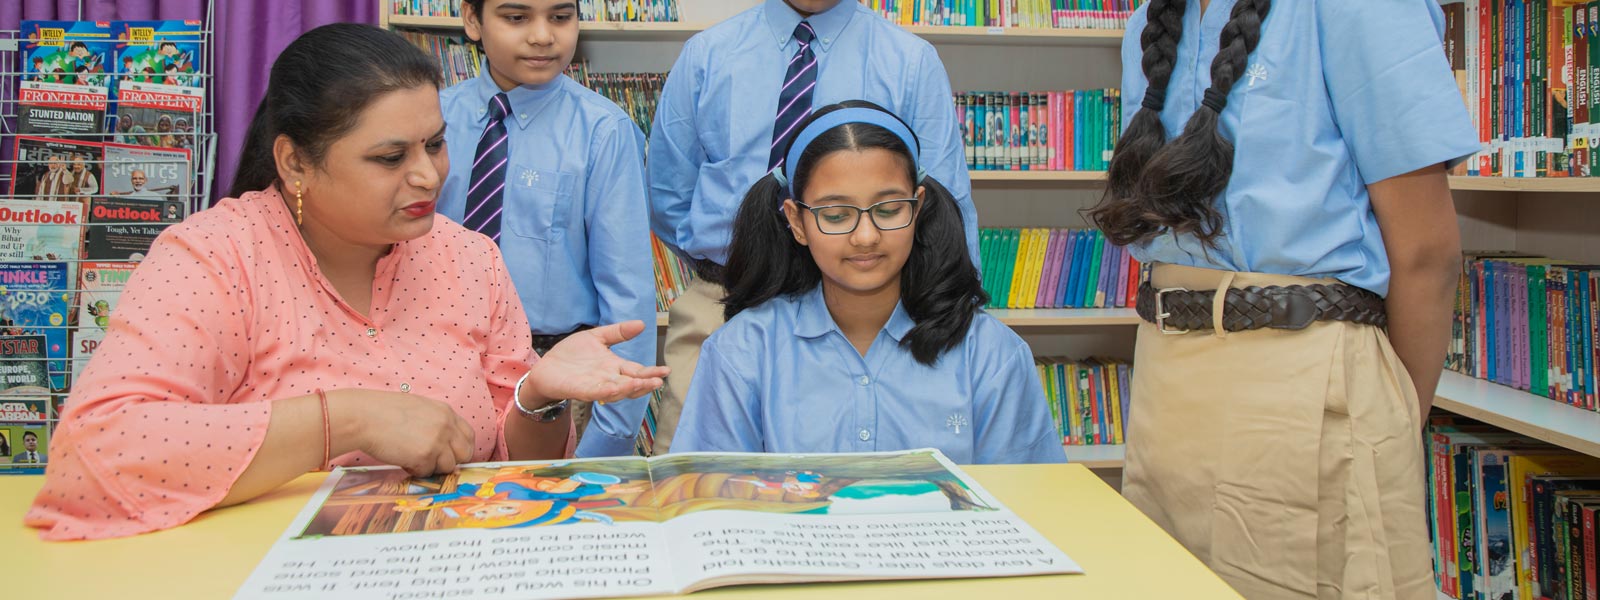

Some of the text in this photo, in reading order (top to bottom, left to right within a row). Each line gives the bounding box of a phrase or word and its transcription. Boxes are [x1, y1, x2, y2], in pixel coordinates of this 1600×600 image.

[22, 90, 105, 107] FRONTLINE
[122, 91, 200, 110] FRONTLINE
[30, 109, 94, 122] STUNTED NATION
[0, 207, 78, 224] Outlook
[93, 205, 160, 221] Outlook
[5, 227, 21, 236] Why
[106, 225, 128, 235] Tough,
[100, 270, 132, 283] TIN
[7, 375, 36, 383] WORLD
[866, 521, 966, 529] Pinocchio
[568, 532, 646, 541] wanted
[582, 543, 647, 551] music
[702, 538, 743, 547] The
[754, 538, 813, 548] boys.
[912, 540, 949, 548] just
[955, 538, 1032, 546] school,
[375, 542, 439, 553] show.
[492, 546, 574, 555] coming
[431, 551, 482, 560] from
[937, 548, 1045, 558] Pinocchio
[548, 554, 628, 564] puppet
[753, 559, 860, 569] Geppetto
[281, 560, 316, 569] He
[428, 564, 460, 573] He
[470, 558, 540, 571] show!
[702, 560, 744, 571] told
[274, 571, 342, 580] some
[350, 568, 418, 578] heard
[535, 566, 650, 576] Pinocchio
[479, 572, 526, 582] saw
[349, 580, 401, 589] tent.
[411, 578, 447, 587] big
[515, 581, 563, 591] way
[573, 580, 607, 588] his
[617, 578, 652, 587] On
[386, 589, 474, 600] school,
